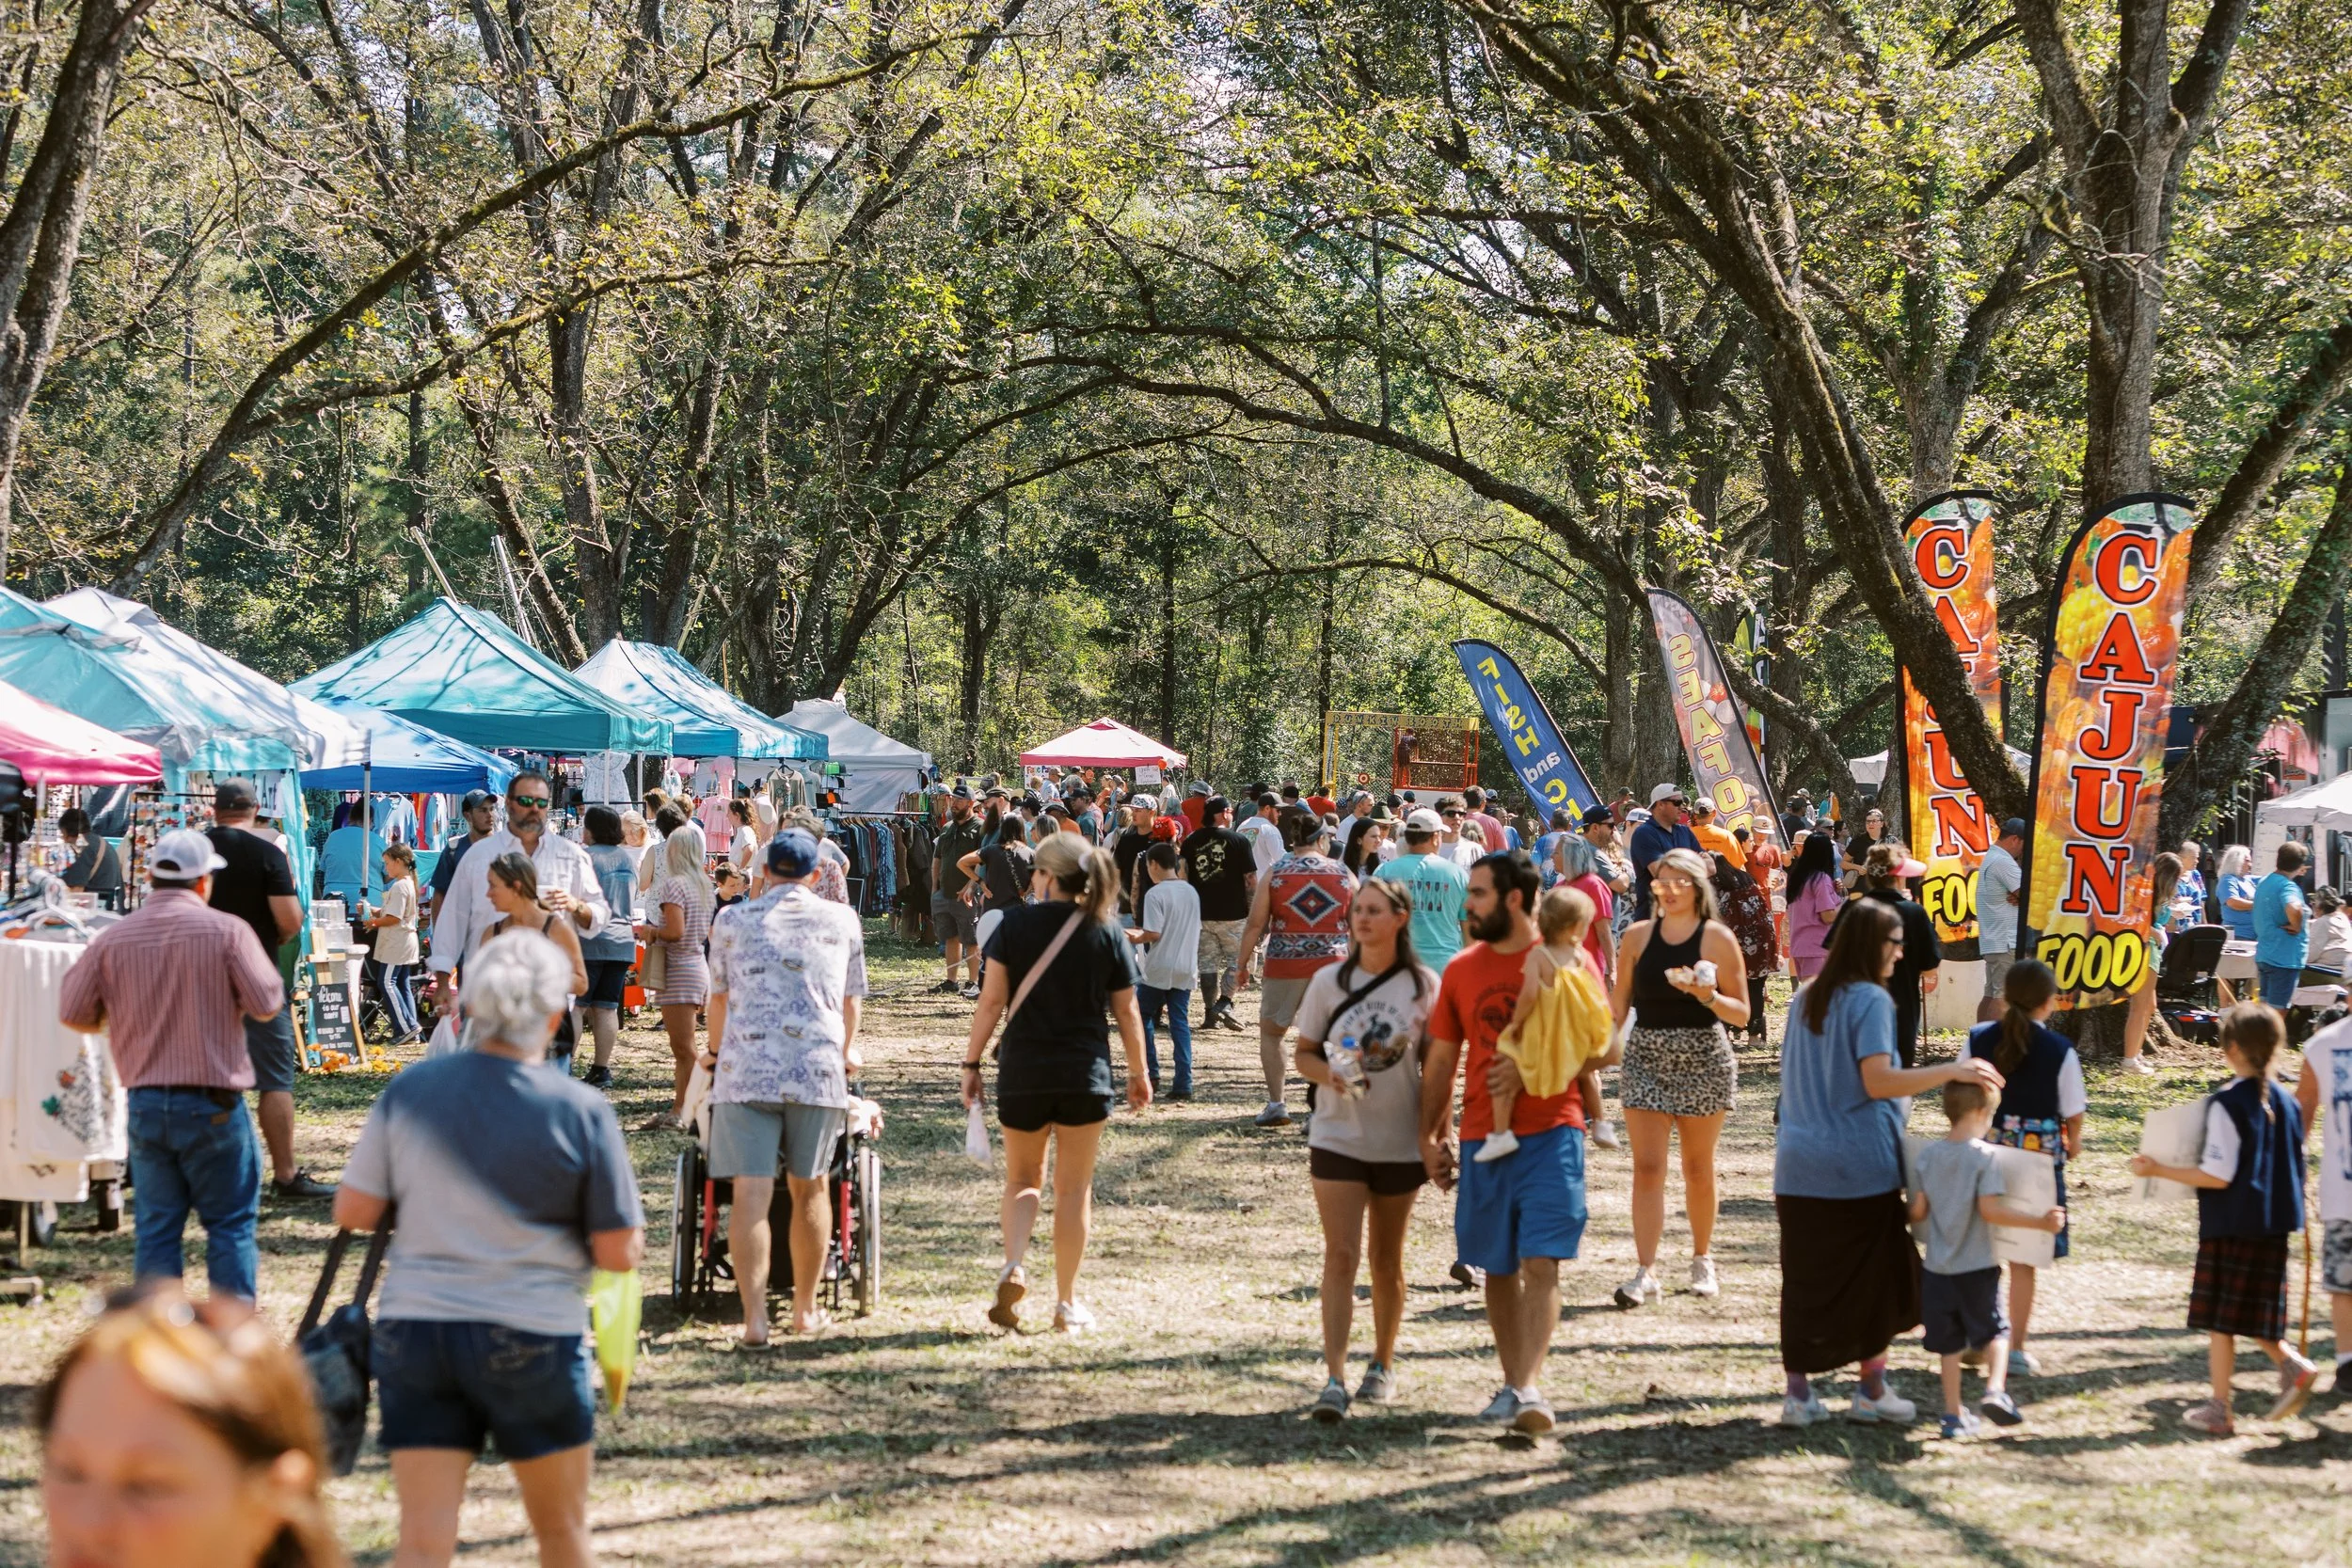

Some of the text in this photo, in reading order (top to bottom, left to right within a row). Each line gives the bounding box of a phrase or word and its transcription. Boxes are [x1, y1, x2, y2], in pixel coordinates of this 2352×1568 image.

[1915, 526, 1990, 857] CAUN
[2059, 531, 2160, 916] CAJUN
[2037, 929, 2144, 993] FOOD
